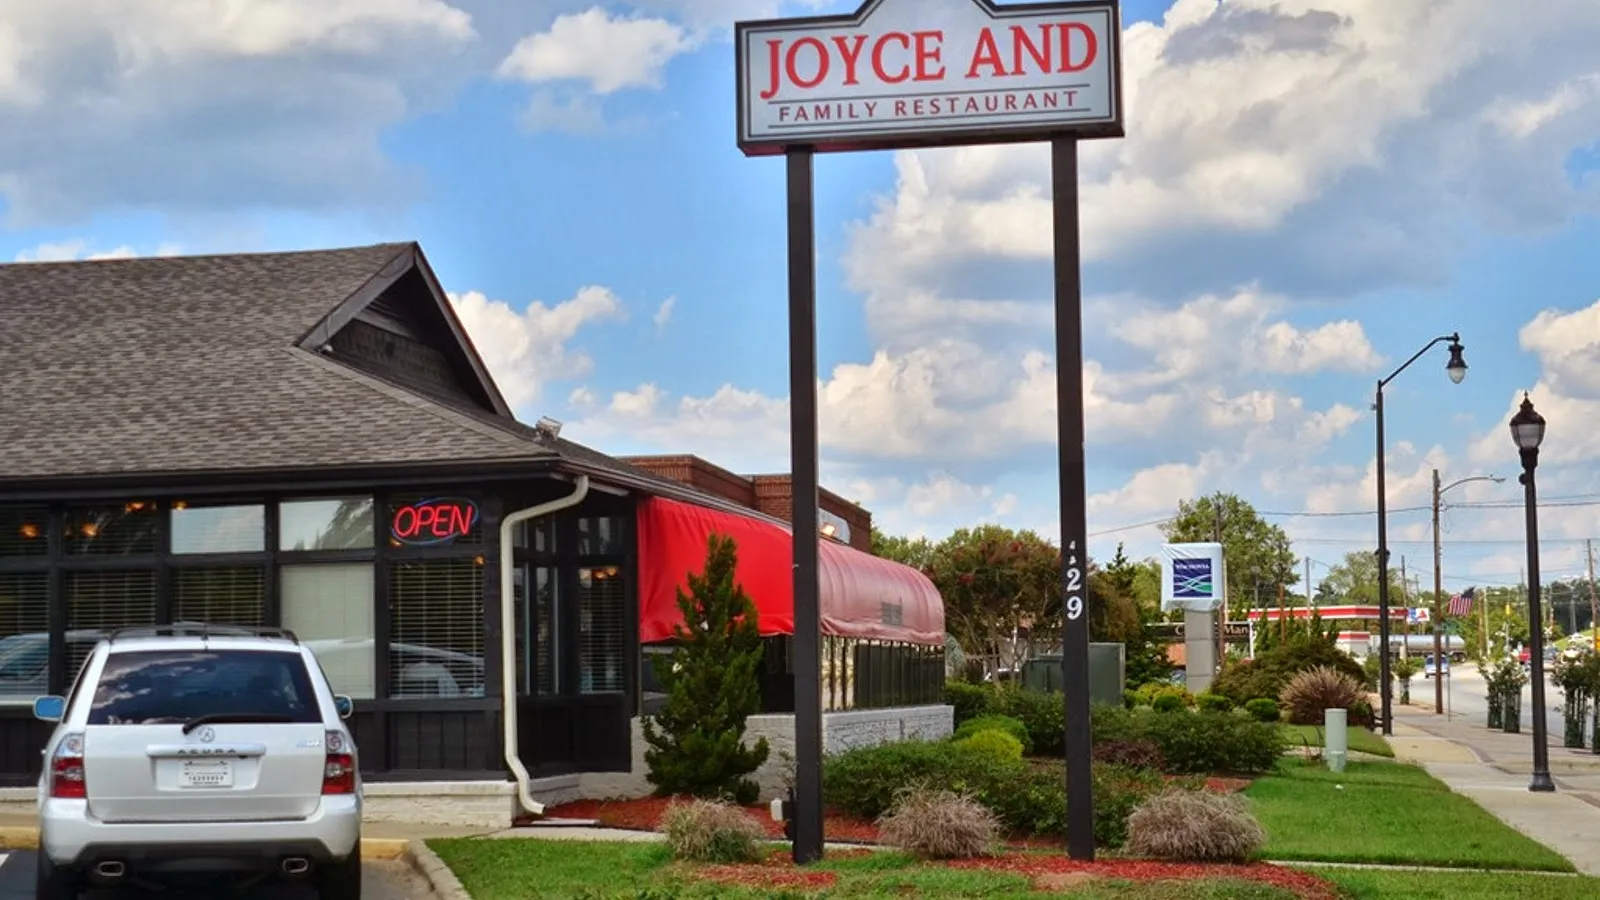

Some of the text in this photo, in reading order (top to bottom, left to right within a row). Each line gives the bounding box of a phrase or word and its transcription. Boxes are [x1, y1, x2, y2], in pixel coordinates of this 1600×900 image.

[760, 22, 1098, 99] JOYCE AND
[779, 91, 1078, 122] FAMILY RESTAURANT
[393, 504, 474, 539] OPEN
